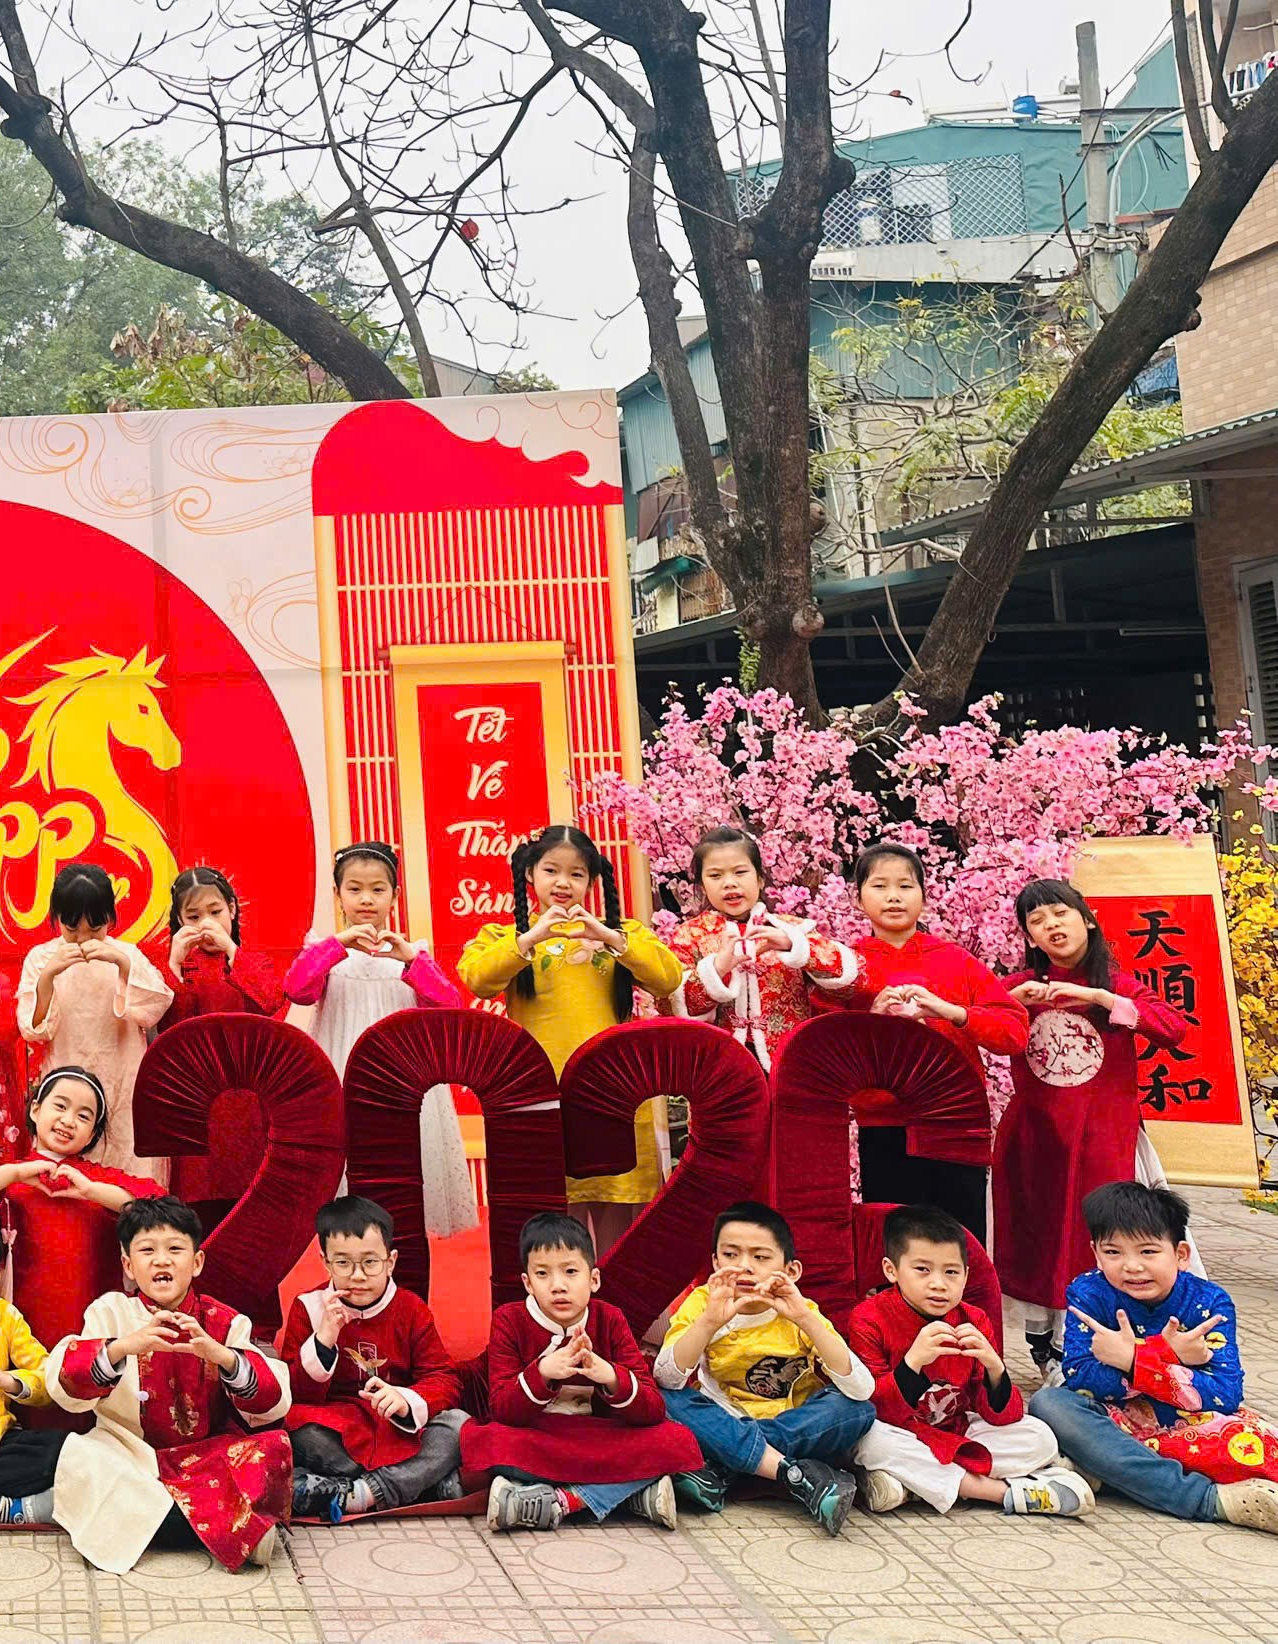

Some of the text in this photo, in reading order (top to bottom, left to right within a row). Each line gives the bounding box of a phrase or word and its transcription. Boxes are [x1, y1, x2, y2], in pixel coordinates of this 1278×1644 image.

[453, 706, 515, 744] Tết
[466, 760, 510, 801] Về
[449, 878, 538, 917] Sán
[133, 1006, 1004, 1374] 2026
